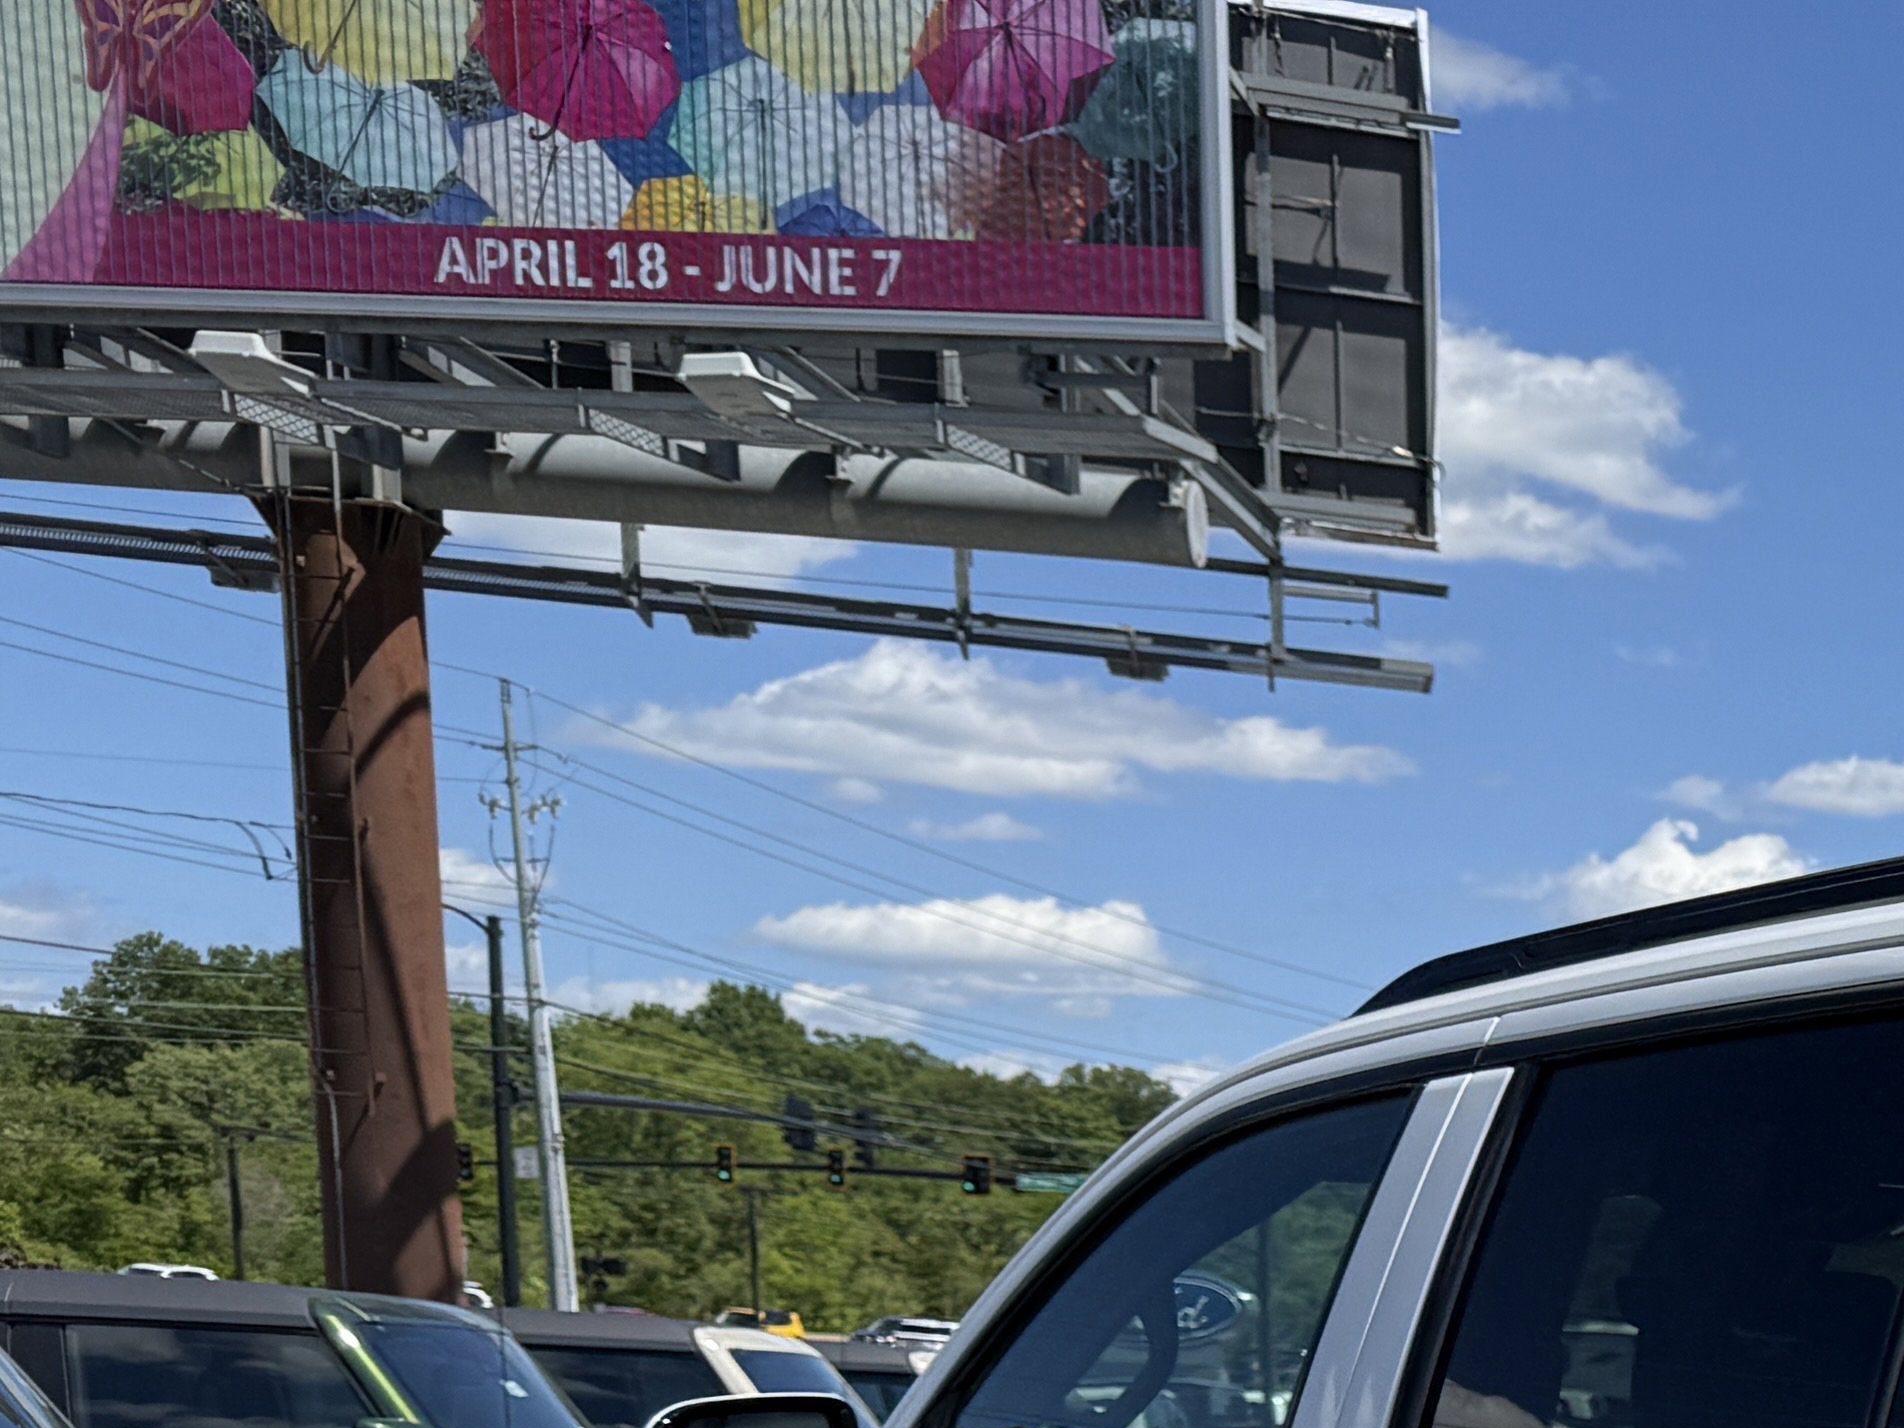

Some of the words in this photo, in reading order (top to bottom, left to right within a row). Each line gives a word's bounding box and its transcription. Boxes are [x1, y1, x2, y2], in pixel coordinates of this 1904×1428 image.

[434, 236, 593, 289] APRIL
[607, 241, 668, 291] 18
[684, 265, 701, 276] -
[715, 244, 857, 296] JUNE
[873, 249, 902, 297] 7
